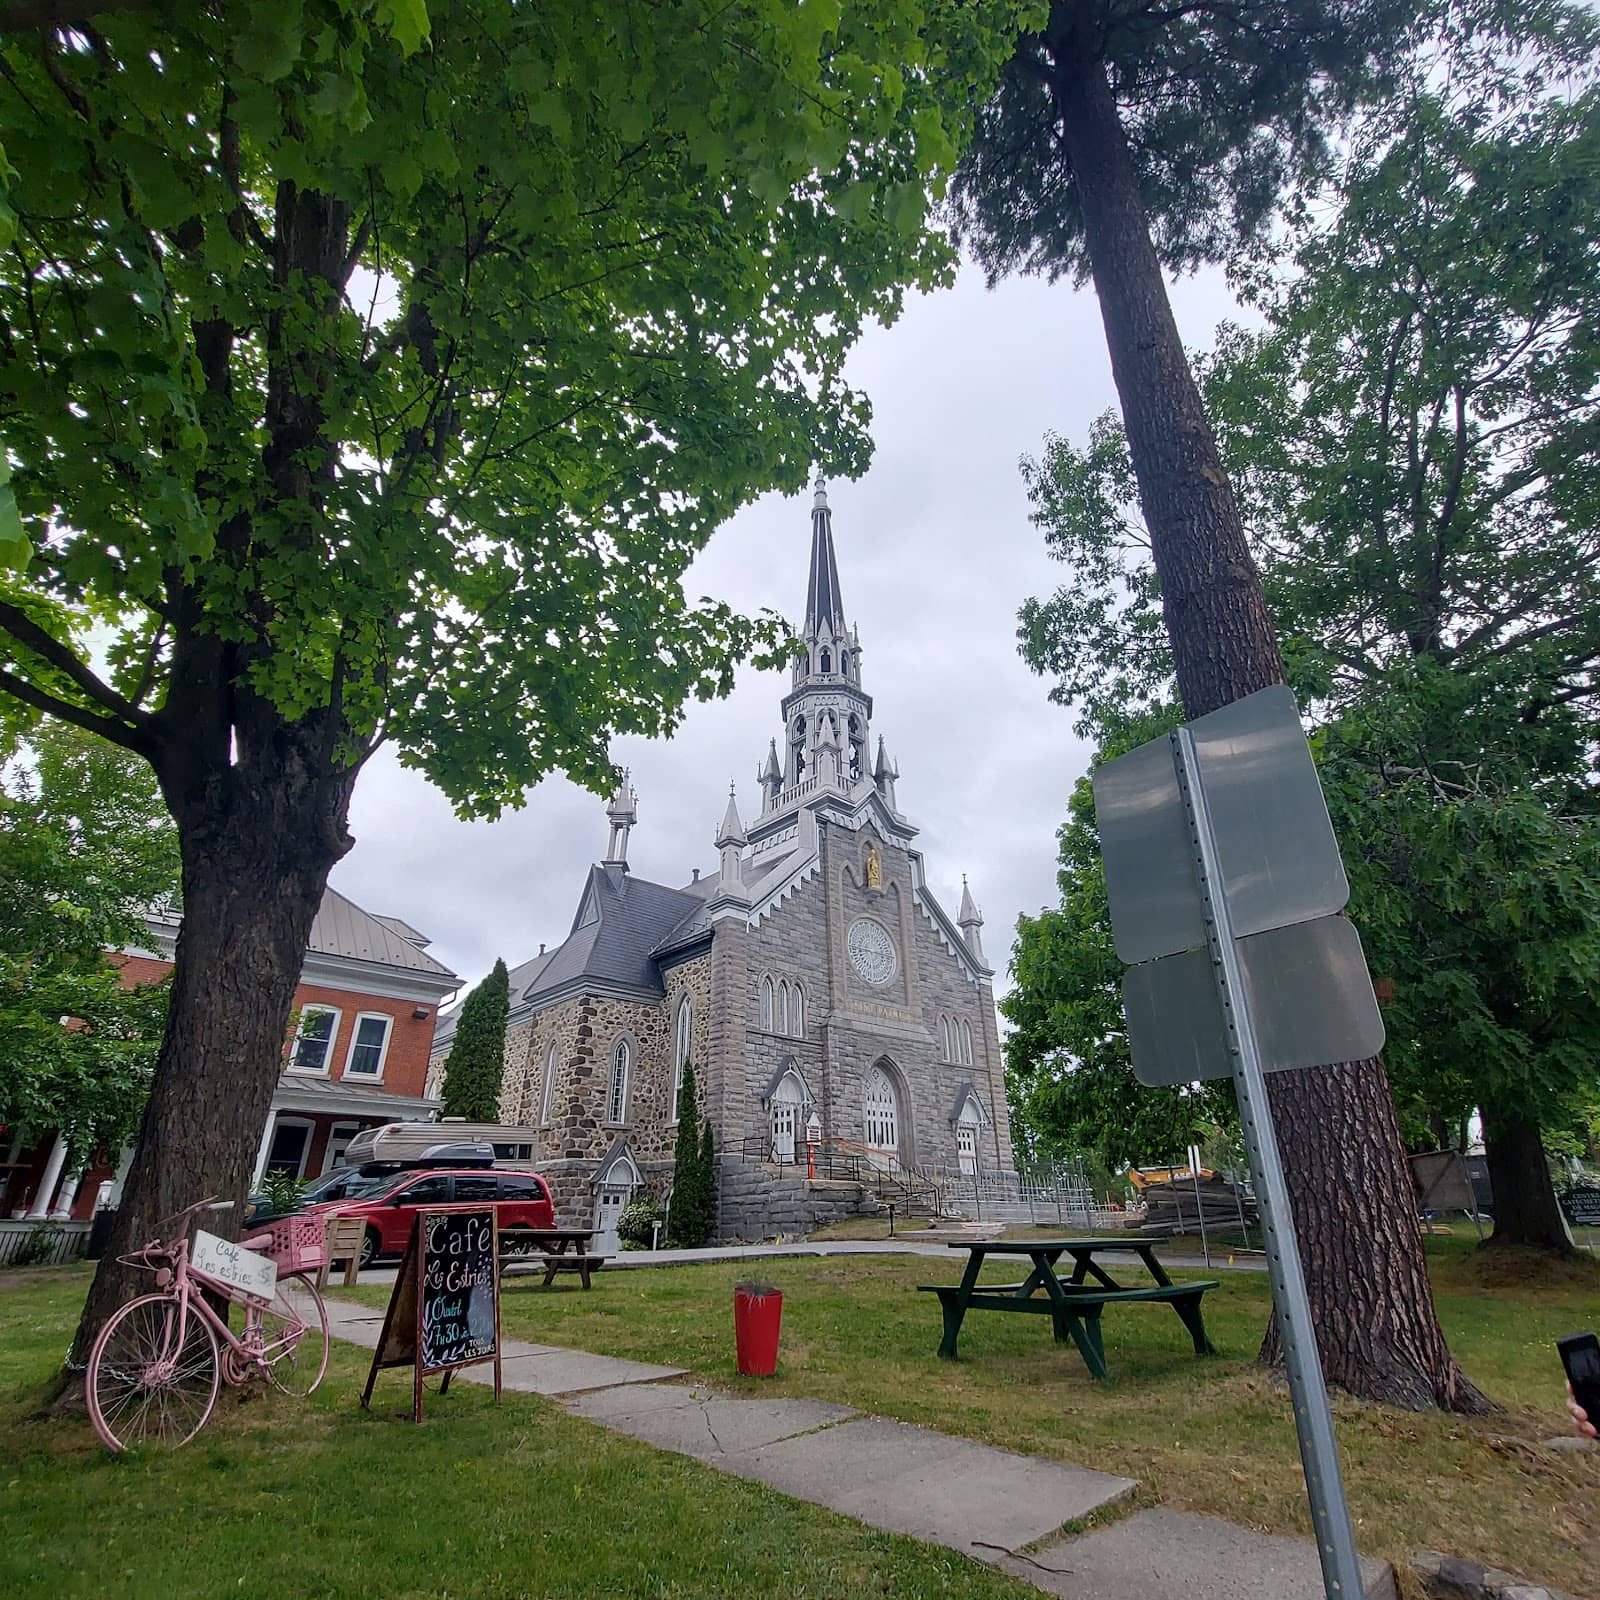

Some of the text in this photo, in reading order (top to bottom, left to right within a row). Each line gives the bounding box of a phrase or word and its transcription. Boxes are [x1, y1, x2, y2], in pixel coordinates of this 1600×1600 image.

[430, 1218, 490, 1255] Café
[216, 1241, 239, 1262] Café
[424, 1259, 487, 1292] Les Estries
[464, 1348, 476, 1358] LES
